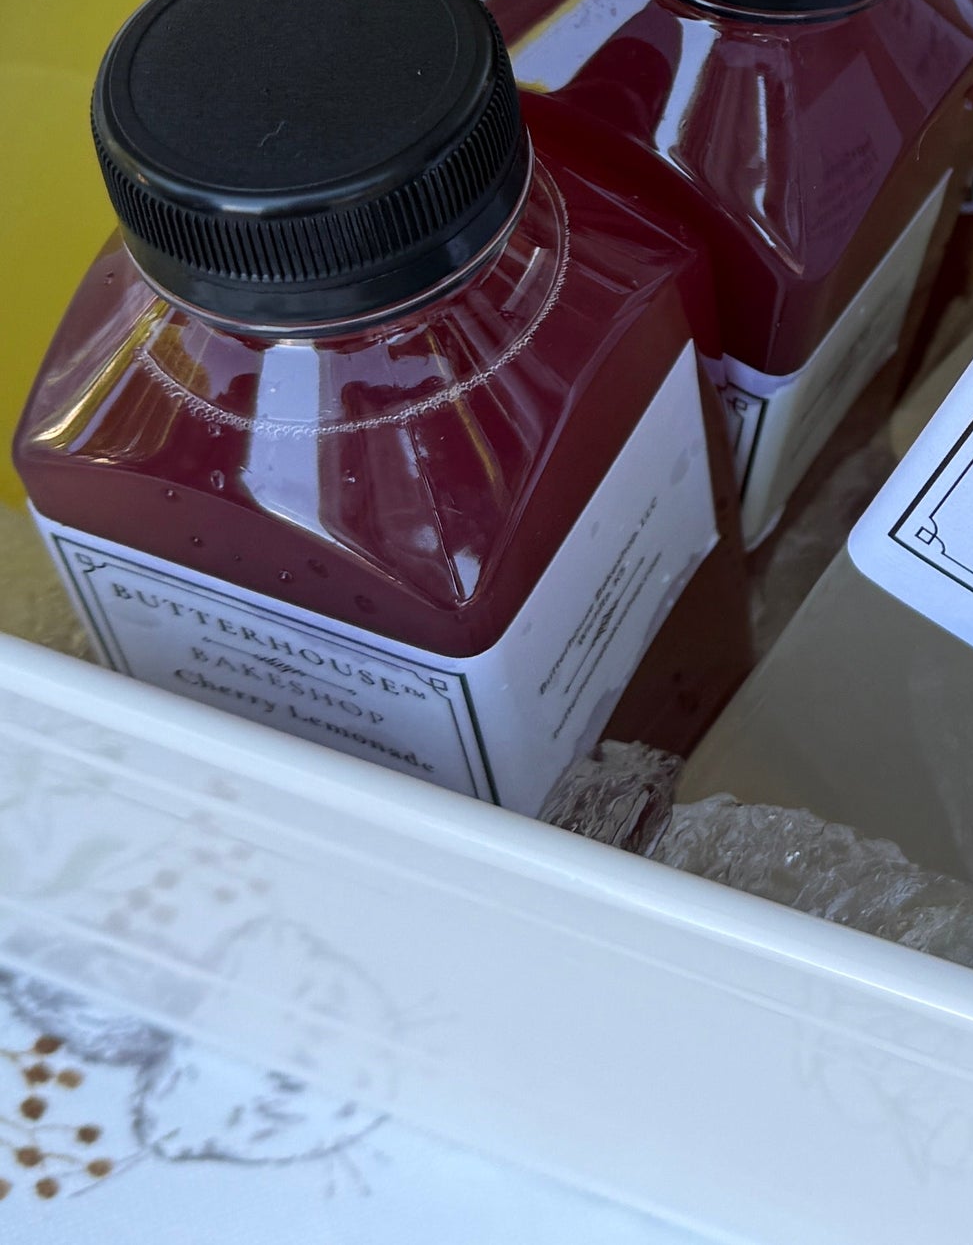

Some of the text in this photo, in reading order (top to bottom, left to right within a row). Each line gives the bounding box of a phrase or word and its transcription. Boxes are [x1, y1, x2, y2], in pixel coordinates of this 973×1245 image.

[174, 668, 436, 773] Cherry Lemonade
[191, 646, 385, 724] BAKESHOP
